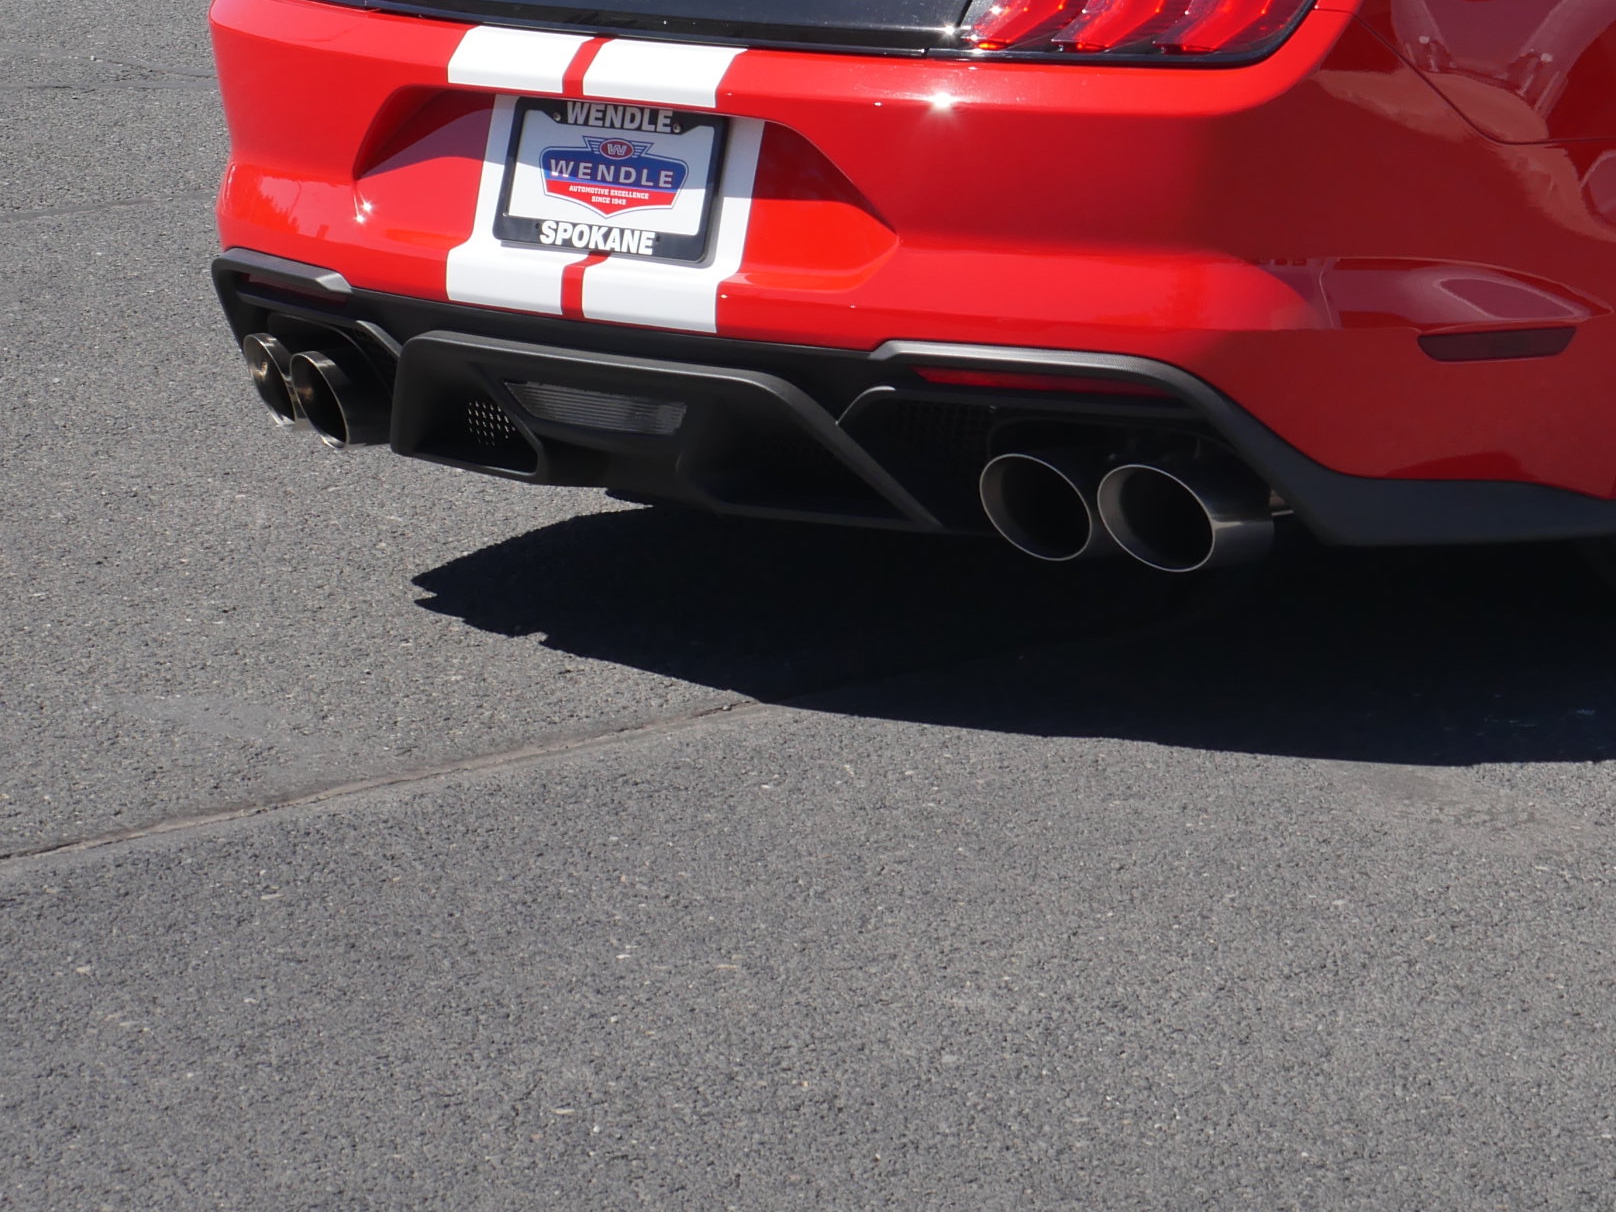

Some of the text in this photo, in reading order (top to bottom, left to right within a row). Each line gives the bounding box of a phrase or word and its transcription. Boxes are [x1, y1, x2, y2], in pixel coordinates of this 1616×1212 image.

[567, 101, 673, 134] WENDLE
[550, 158, 674, 188] WENDLE
[569, 185, 649, 200] AUTOMOTIVE EXCELLENCE
[591, 196, 610, 204] SINCE
[540, 221, 656, 255] SPOKANE
